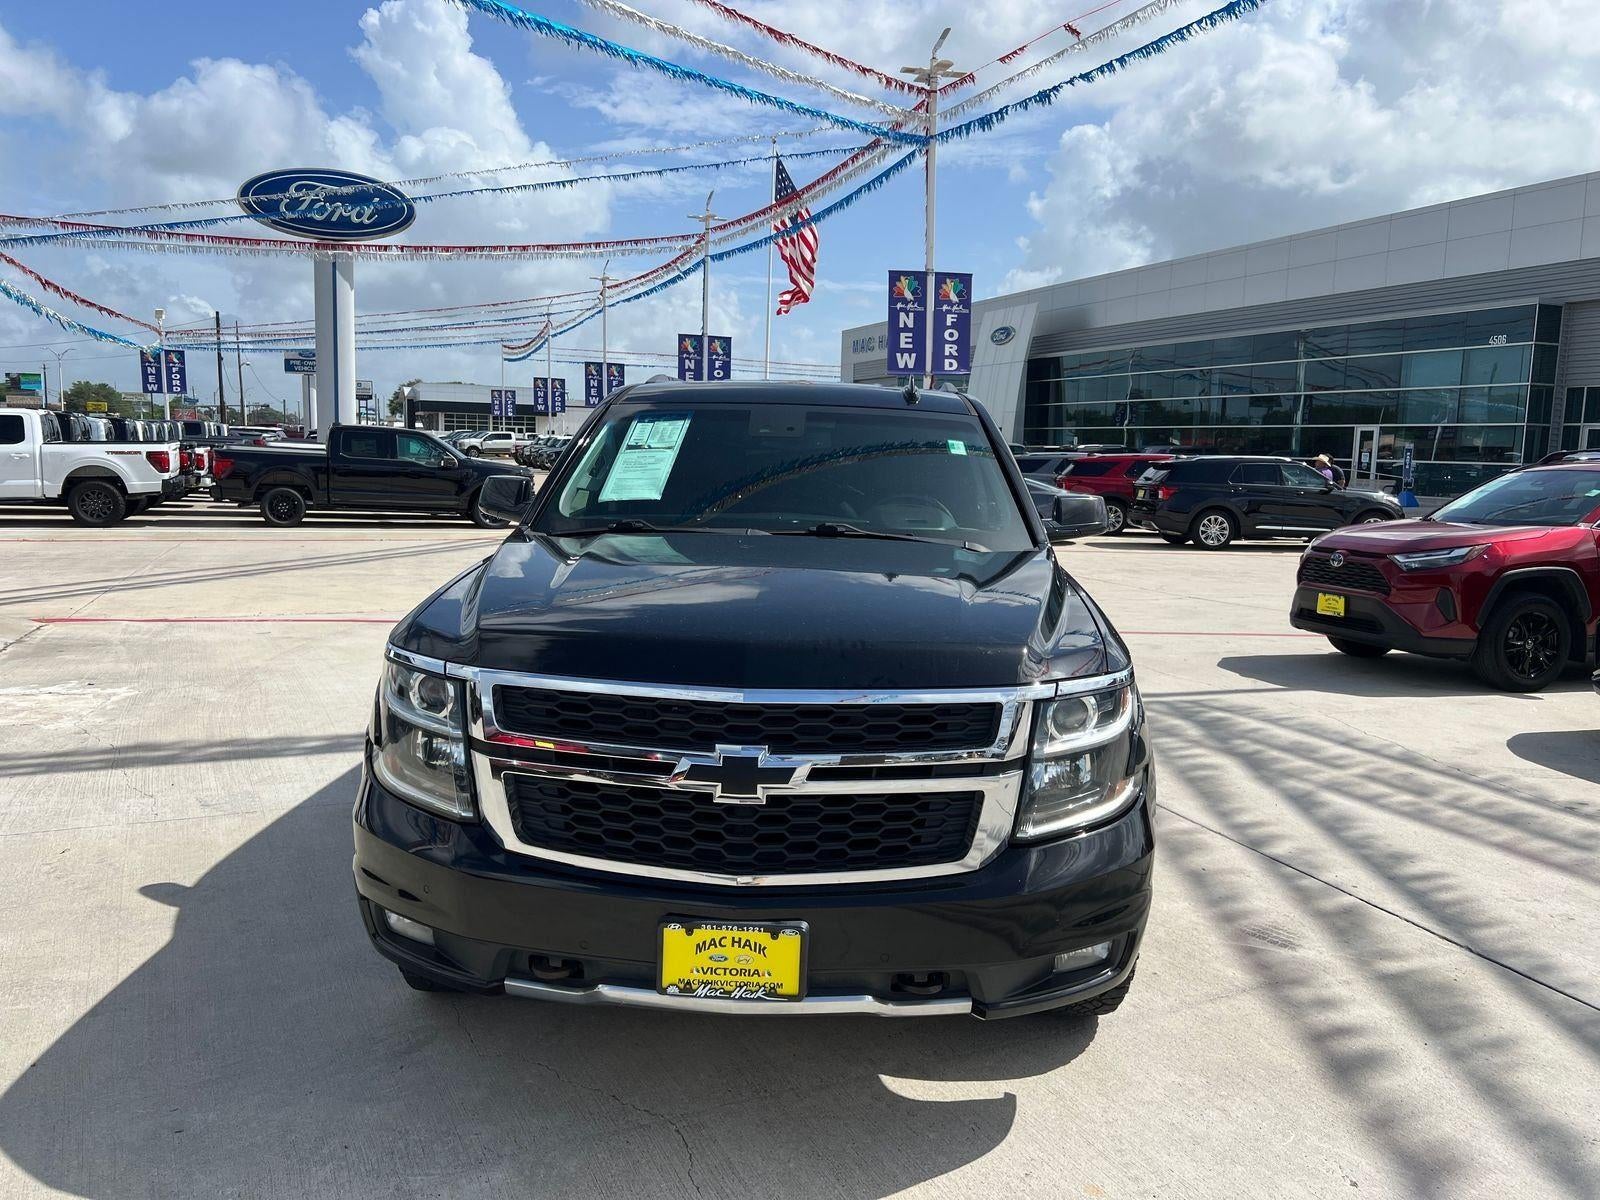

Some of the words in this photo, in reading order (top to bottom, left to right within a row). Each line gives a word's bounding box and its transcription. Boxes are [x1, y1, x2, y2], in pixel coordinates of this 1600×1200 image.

[280, 181, 379, 224] Ford
[852, 337, 874, 352] MAC
[896, 312, 916, 368] NEW
[944, 314, 959, 370] FORD
[147, 366, 158, 391] NEW
[171, 367, 181, 392] FORD
[685, 359, 694, 381] NE
[713, 360, 724, 378] FO
[537, 391, 545, 410] NEW
[589, 379, 599, 404] NEW
[695, 936, 727, 955] MAC
[731, 936, 767, 958] HAIK
[700, 966, 761, 978] VICTORIA
[693, 983, 724, 998] Mac
[730, 985, 768, 999] Haik
